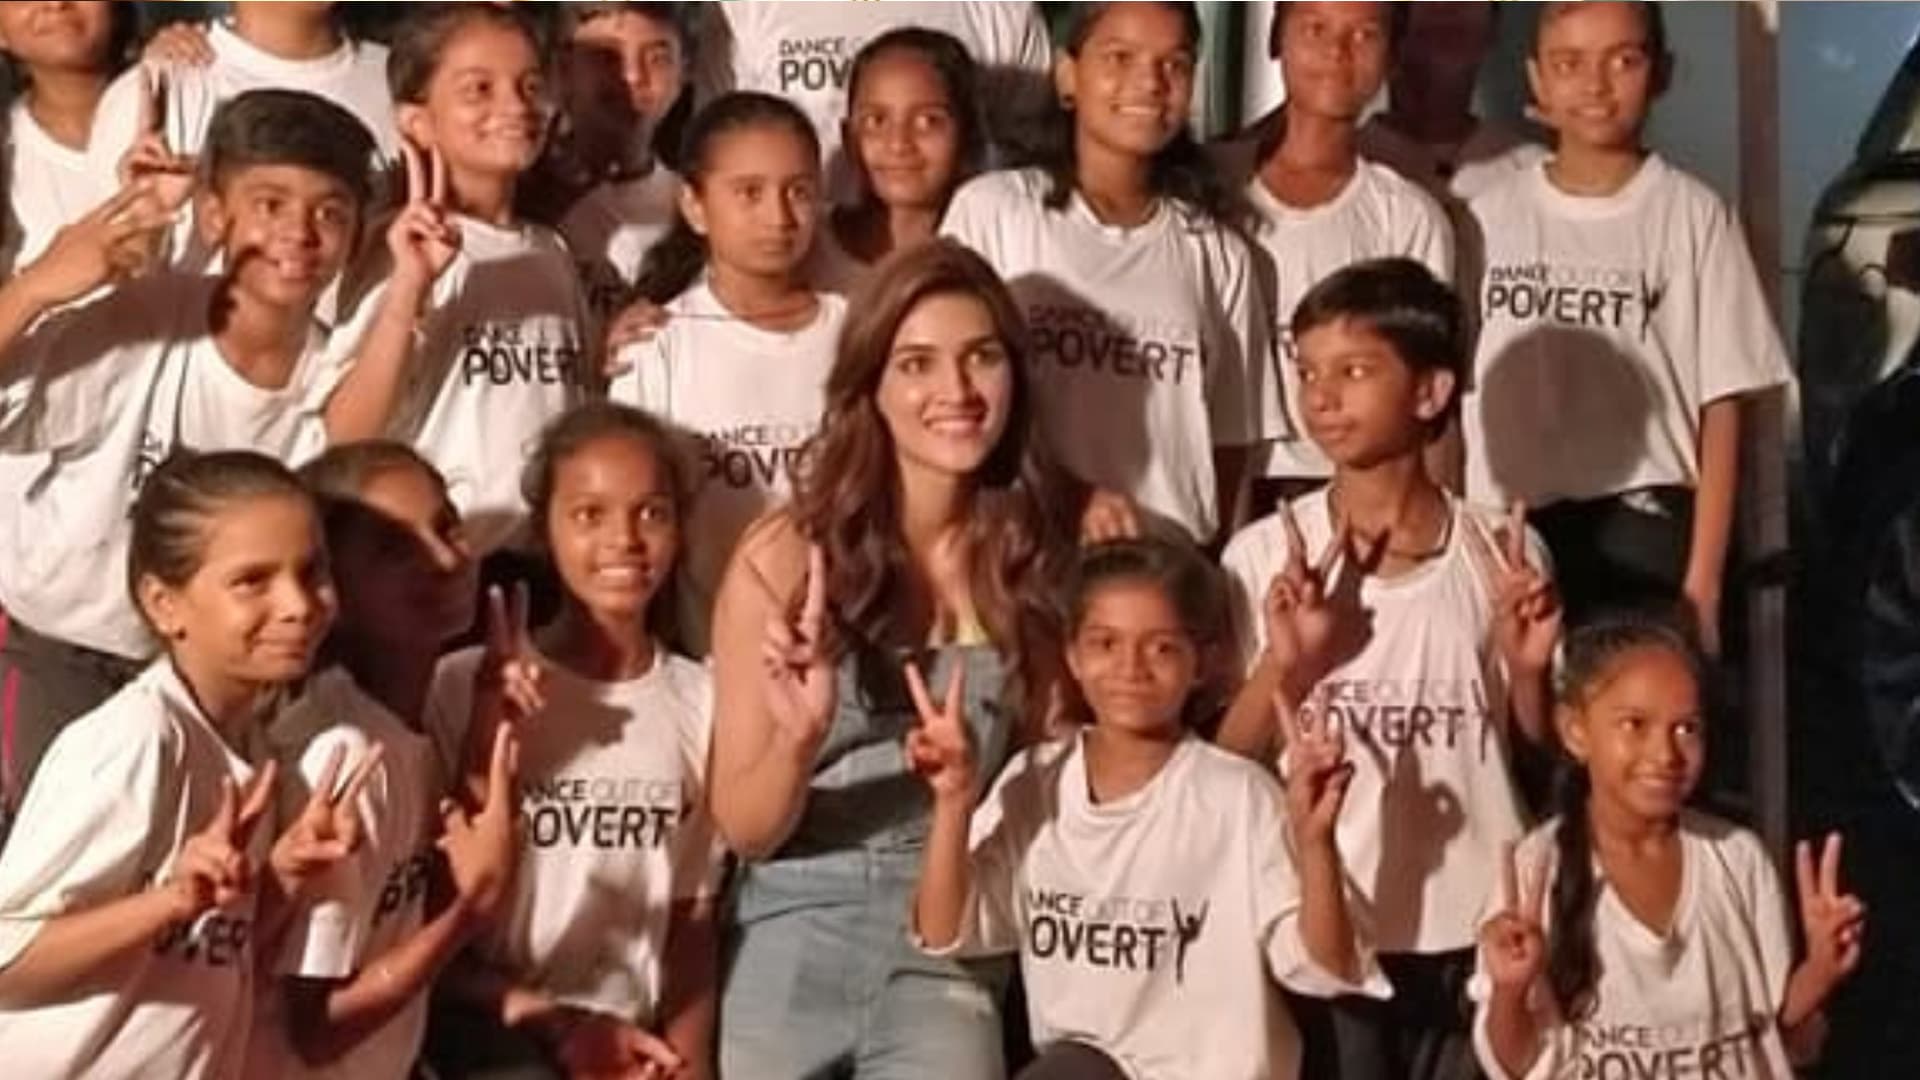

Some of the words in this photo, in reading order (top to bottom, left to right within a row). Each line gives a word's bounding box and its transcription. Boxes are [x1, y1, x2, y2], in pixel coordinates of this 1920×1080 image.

[780, 57, 848, 91] POV
[463, 345, 580, 387] POVER
[522, 779, 588, 804] ANCE
[522, 802, 692, 850] OVERT
[1028, 888, 1084, 918] ANCE
[1581, 1023, 1653, 1049] ANCE
